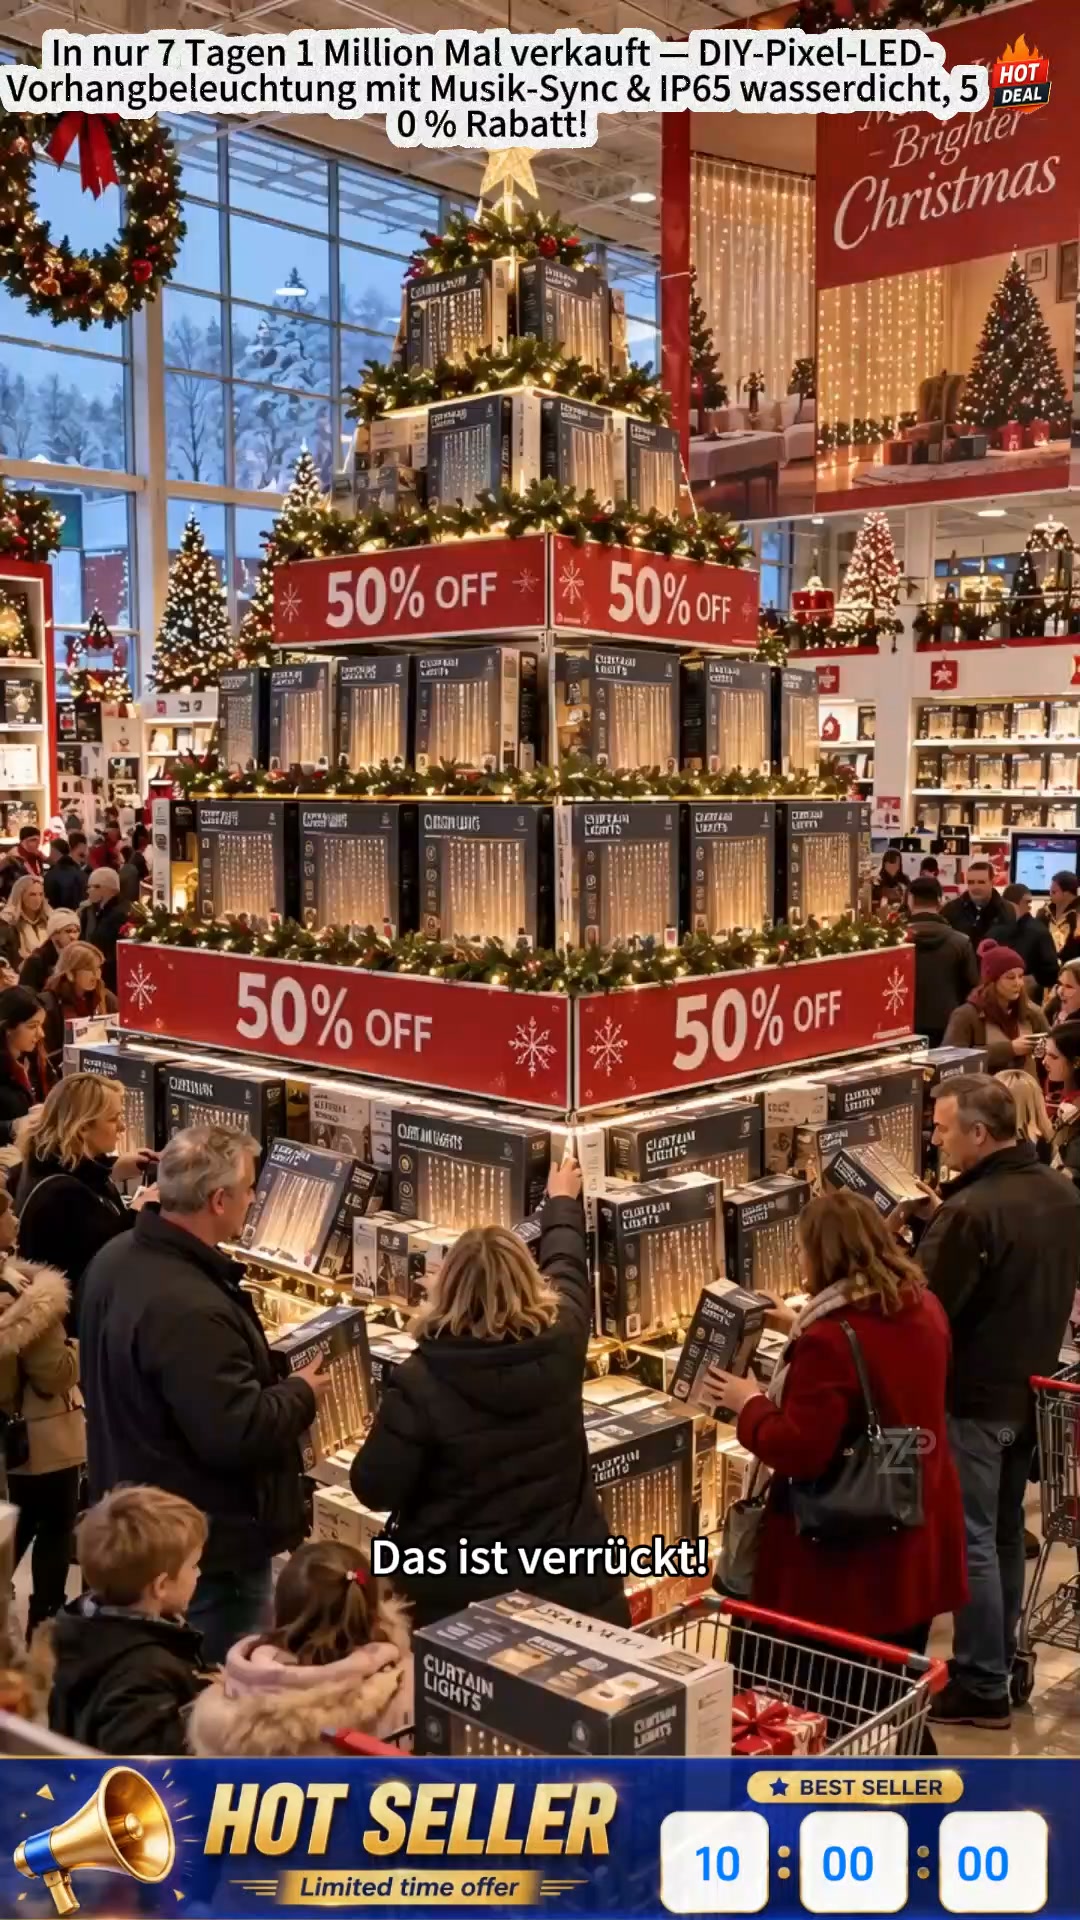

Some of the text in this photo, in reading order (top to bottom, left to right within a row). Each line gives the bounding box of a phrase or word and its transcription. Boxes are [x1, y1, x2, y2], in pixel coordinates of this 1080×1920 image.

[889, 109, 1025, 169] Brighter
[833, 155, 1060, 250] Christmas
[325, 564, 497, 629] 50% OFF
[608, 560, 732, 626] 50% OFF
[236, 971, 433, 1053] 50% OFF
[672, 984, 842, 1072] 50% OFF
[423, 1653, 494, 1699] CURTAIN
[424, 1671, 481, 1711] LIGHTS
